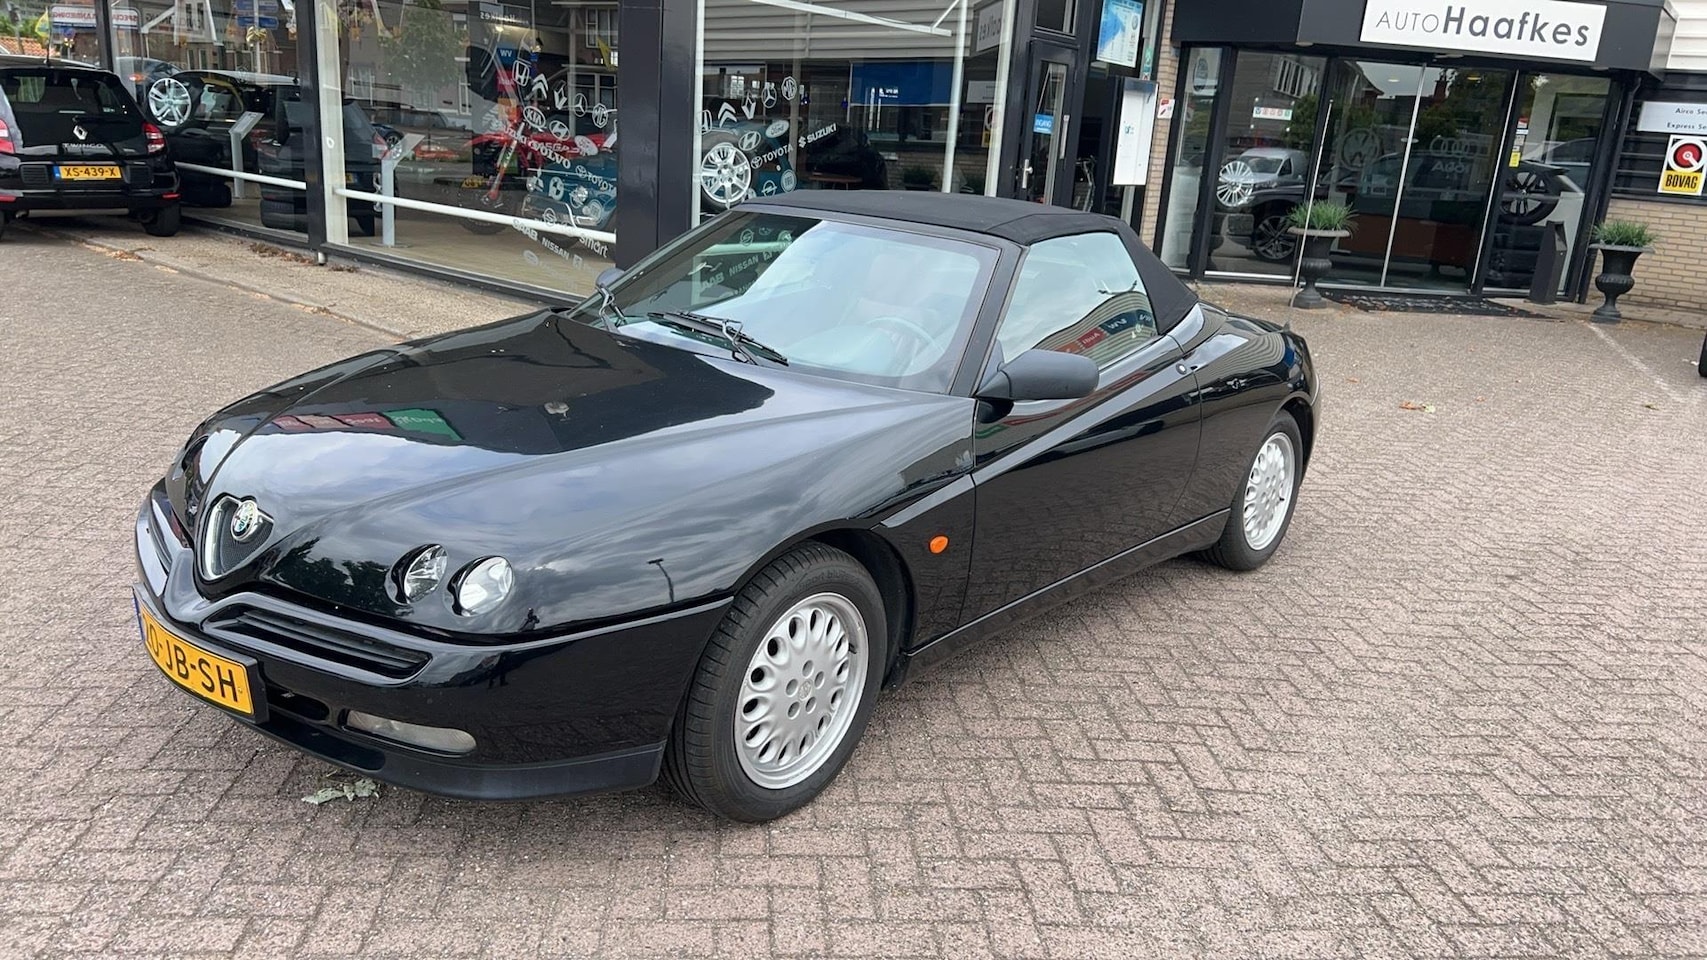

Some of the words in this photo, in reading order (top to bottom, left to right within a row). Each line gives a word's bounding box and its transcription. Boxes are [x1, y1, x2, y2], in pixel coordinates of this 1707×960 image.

[807, 124, 837, 143] SUZUKI
[1667, 122, 1695, 130] Express
[762, 143, 793, 163] TOYOTA
[65, 167, 117, 177] XS-439-X
[1665, 174, 1698, 189] BOVAG
[541, 237, 570, 260] NISSAN
[728, 255, 759, 277] NISSAN
